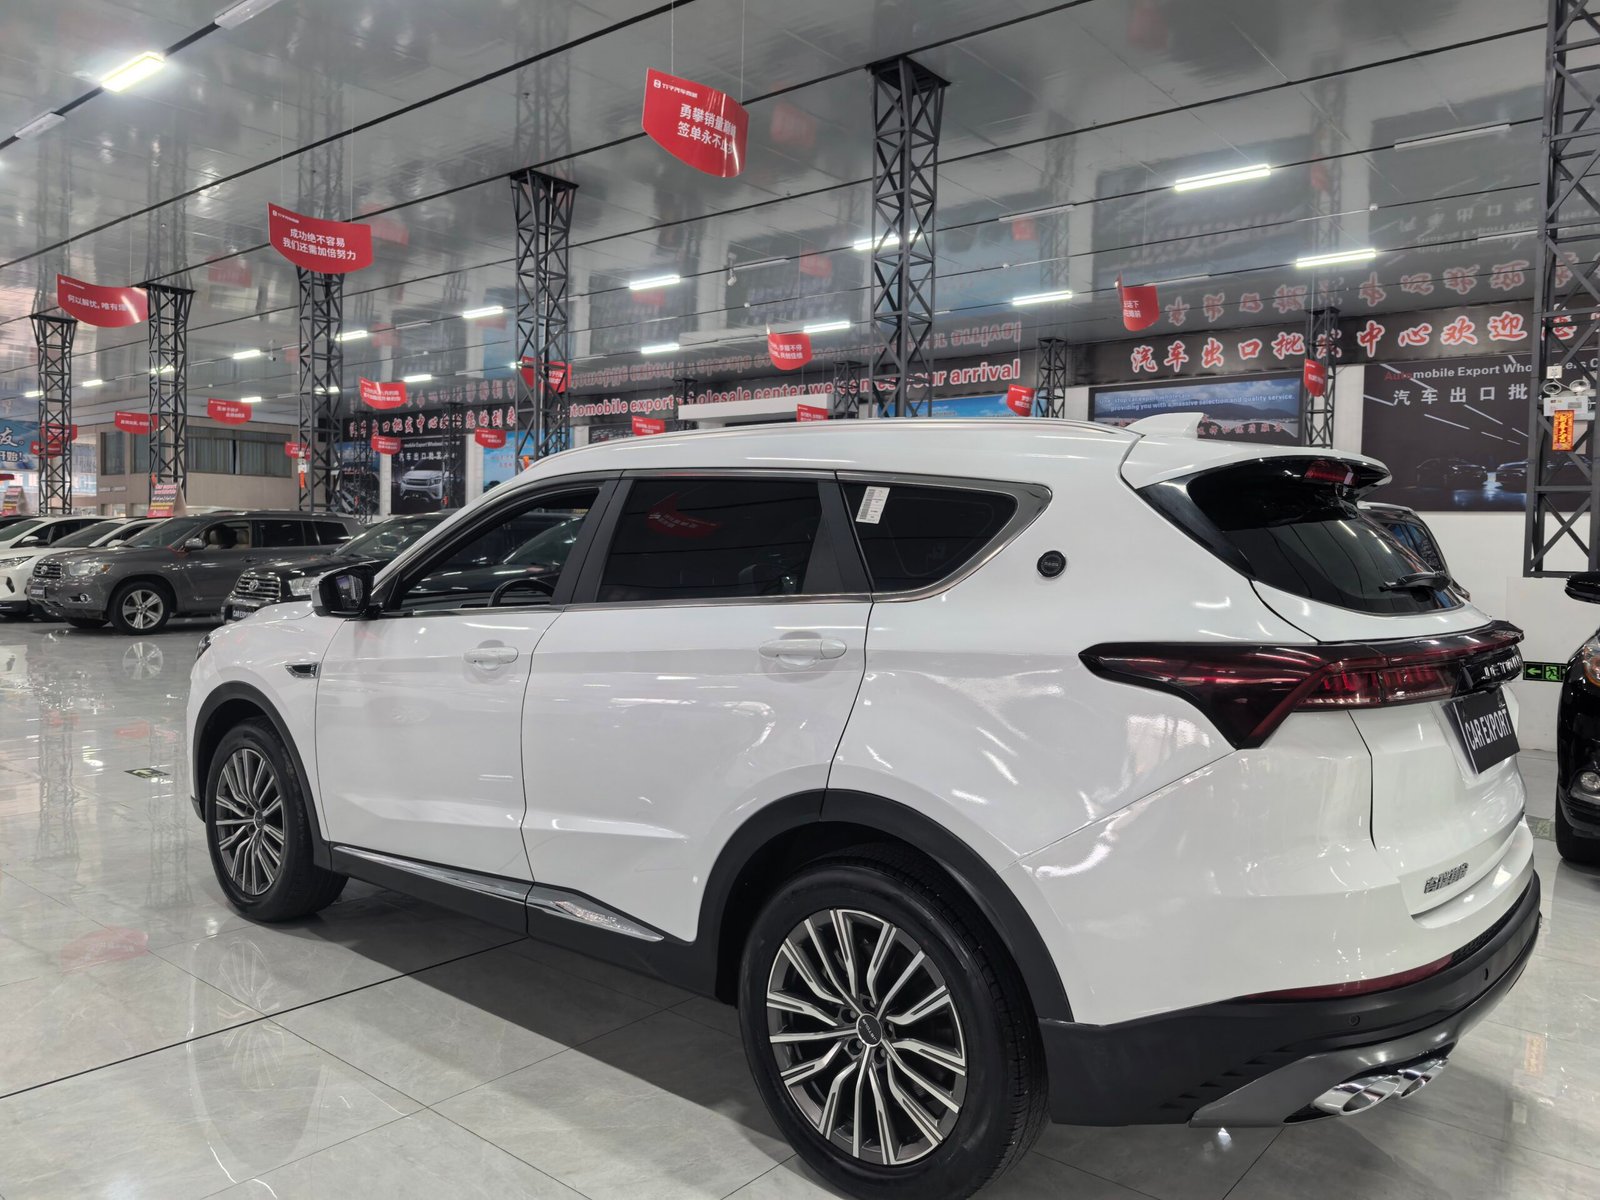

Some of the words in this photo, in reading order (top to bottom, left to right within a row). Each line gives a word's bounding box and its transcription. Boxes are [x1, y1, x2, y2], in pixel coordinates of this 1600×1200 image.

[282, 237, 357, 261] 我们还需加倍努力
[290, 228, 346, 248] 成功绝不容易
[1385, 367, 1455, 381] Automobile
[1457, 366, 1501, 381] Export
[630, 394, 675, 413] export
[754, 382, 807, 400] center
[949, 357, 1022, 386] arrival
[1110, 403, 1139, 413] providing
[1140, 402, 1152, 411] you
[1199, 397, 1228, 406] selection
[1244, 394, 1266, 404] quality
[1464, 717, 1485, 751] CAR
[1481, 708, 1512, 745] EXPORT
